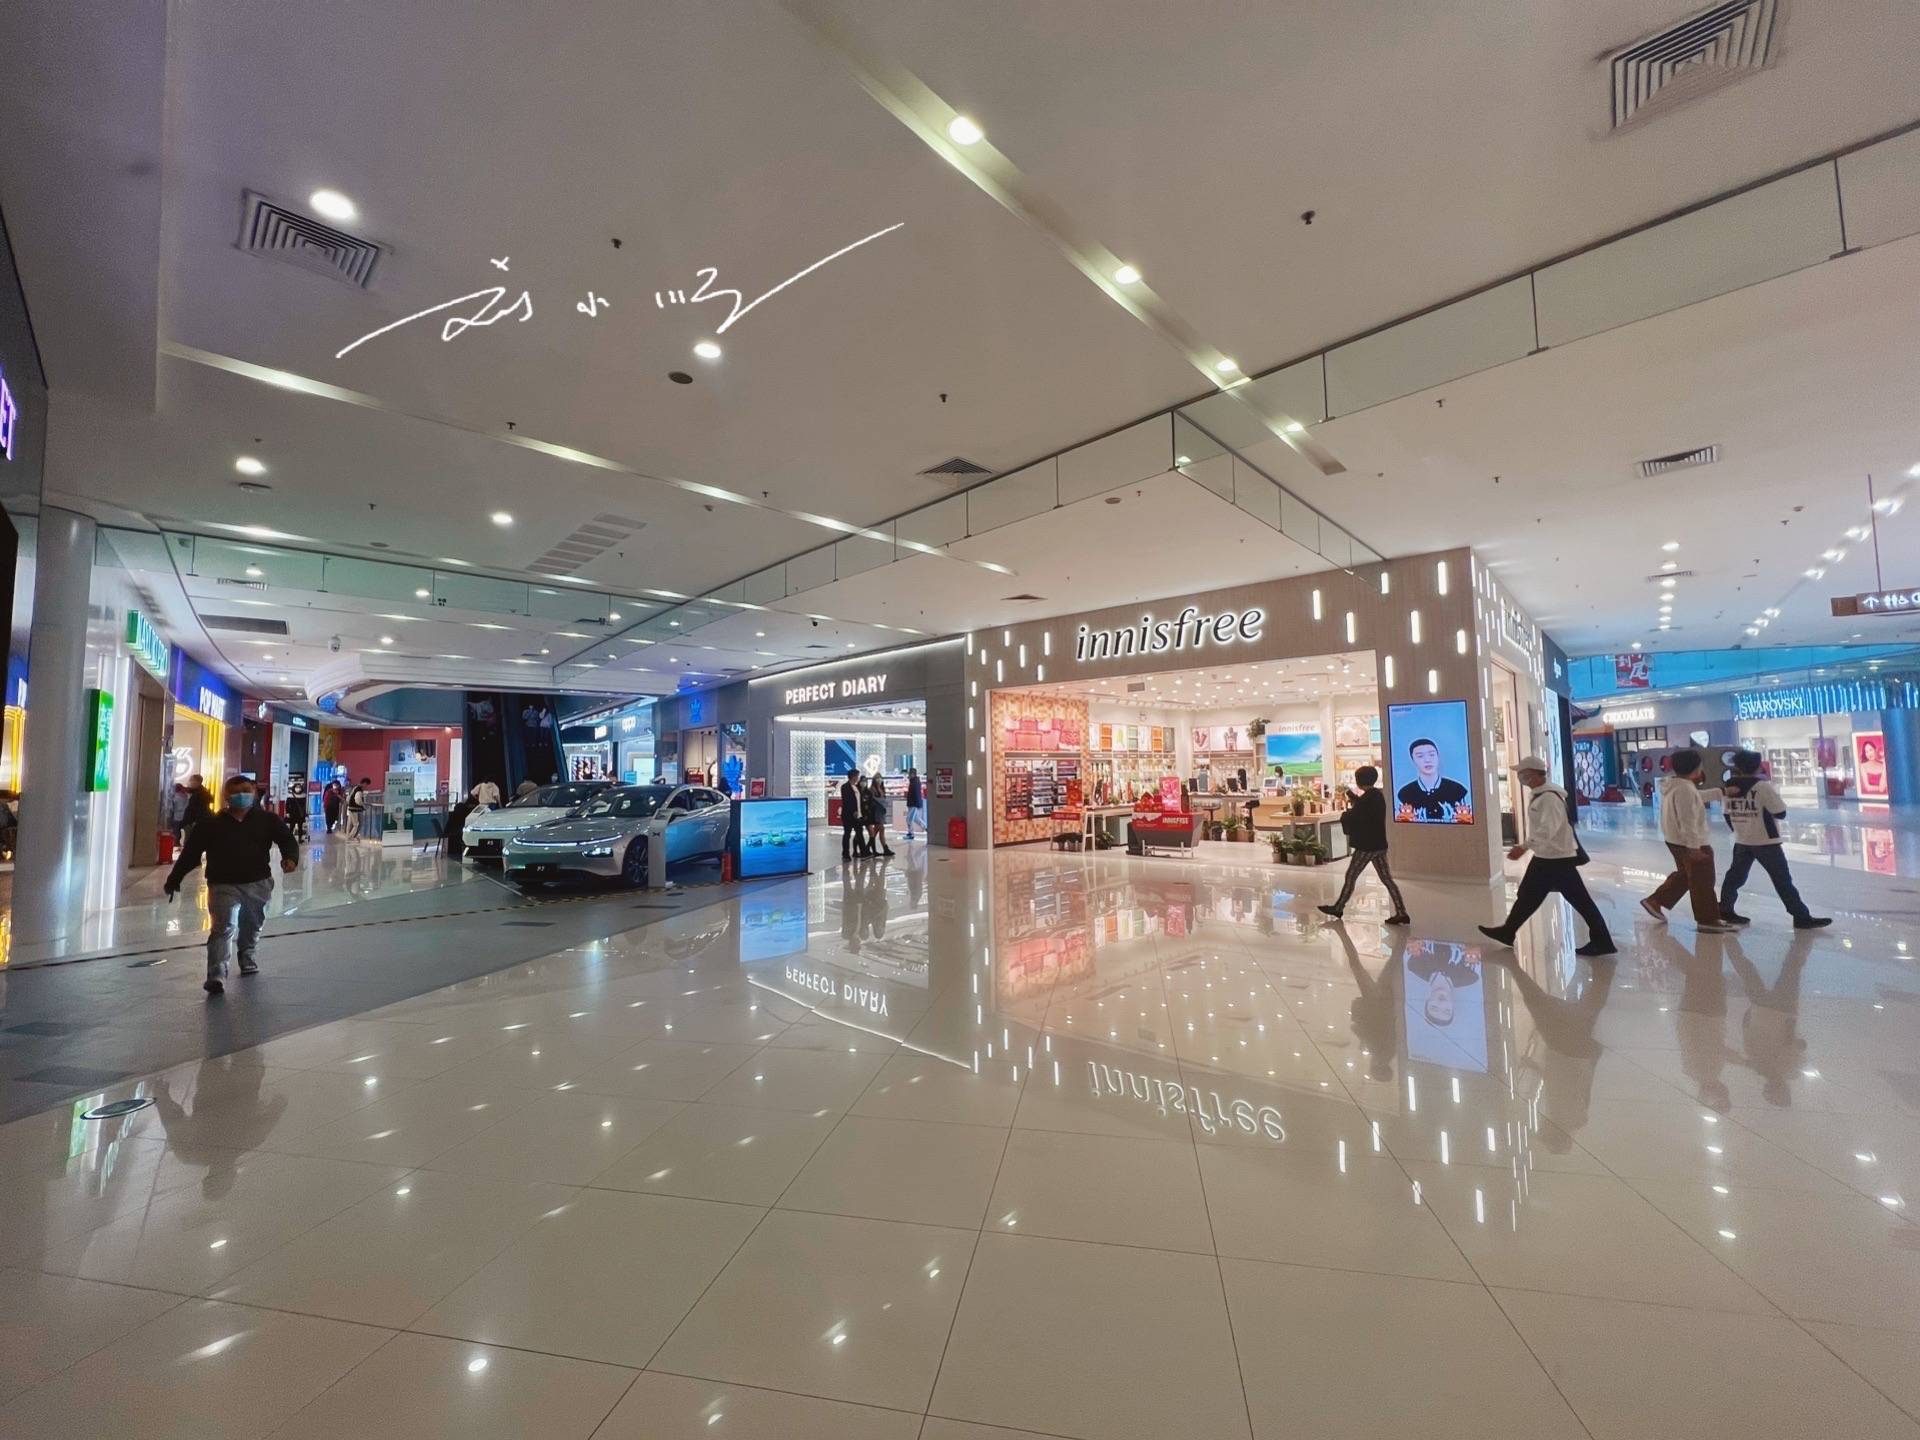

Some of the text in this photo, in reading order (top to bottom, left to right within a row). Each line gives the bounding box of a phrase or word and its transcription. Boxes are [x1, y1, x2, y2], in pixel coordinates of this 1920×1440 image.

[1075, 605, 1265, 662] innisfree
[785, 674, 888, 705] PERFECT DIARY
[1741, 695, 1804, 714] SWAROVSKI
